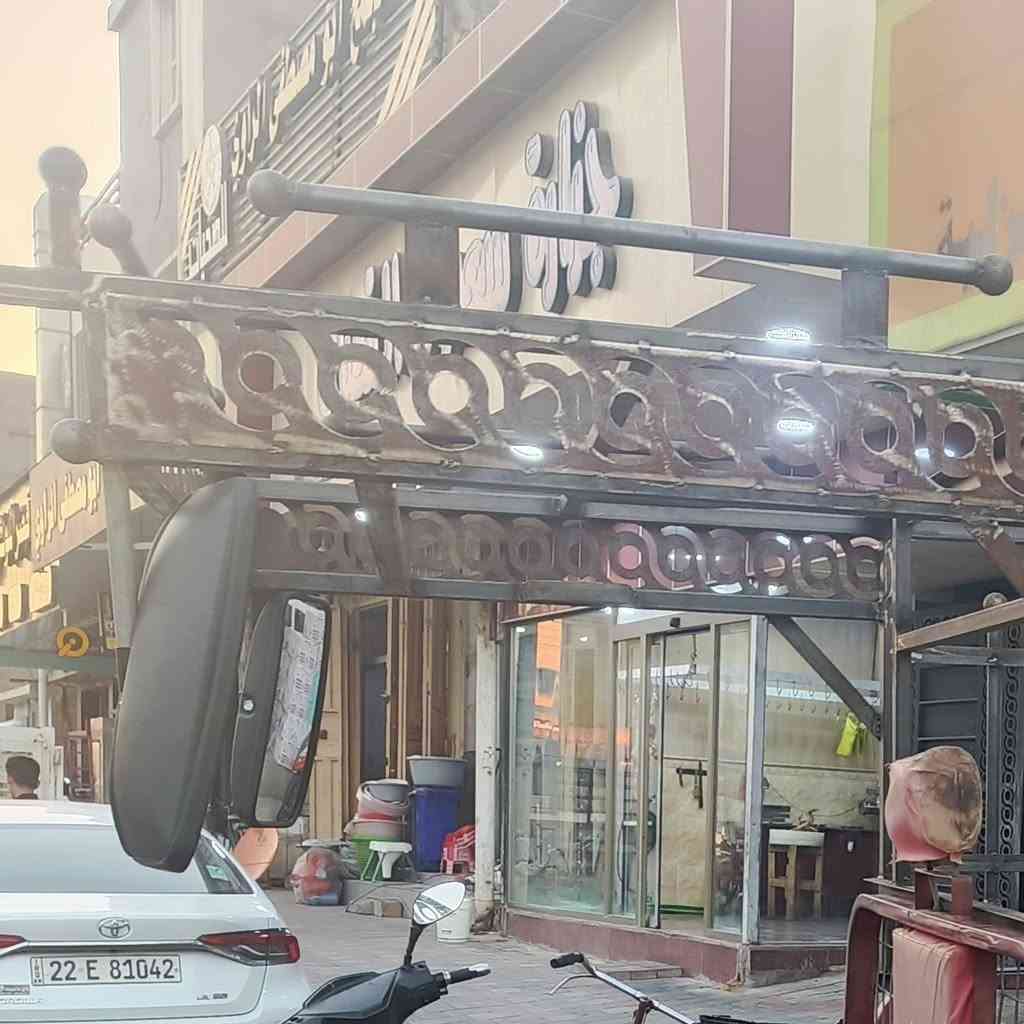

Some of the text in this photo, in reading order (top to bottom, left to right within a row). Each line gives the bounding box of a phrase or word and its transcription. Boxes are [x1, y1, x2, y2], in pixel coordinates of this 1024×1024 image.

[49, 959, 175, 981] 22 E 81042
